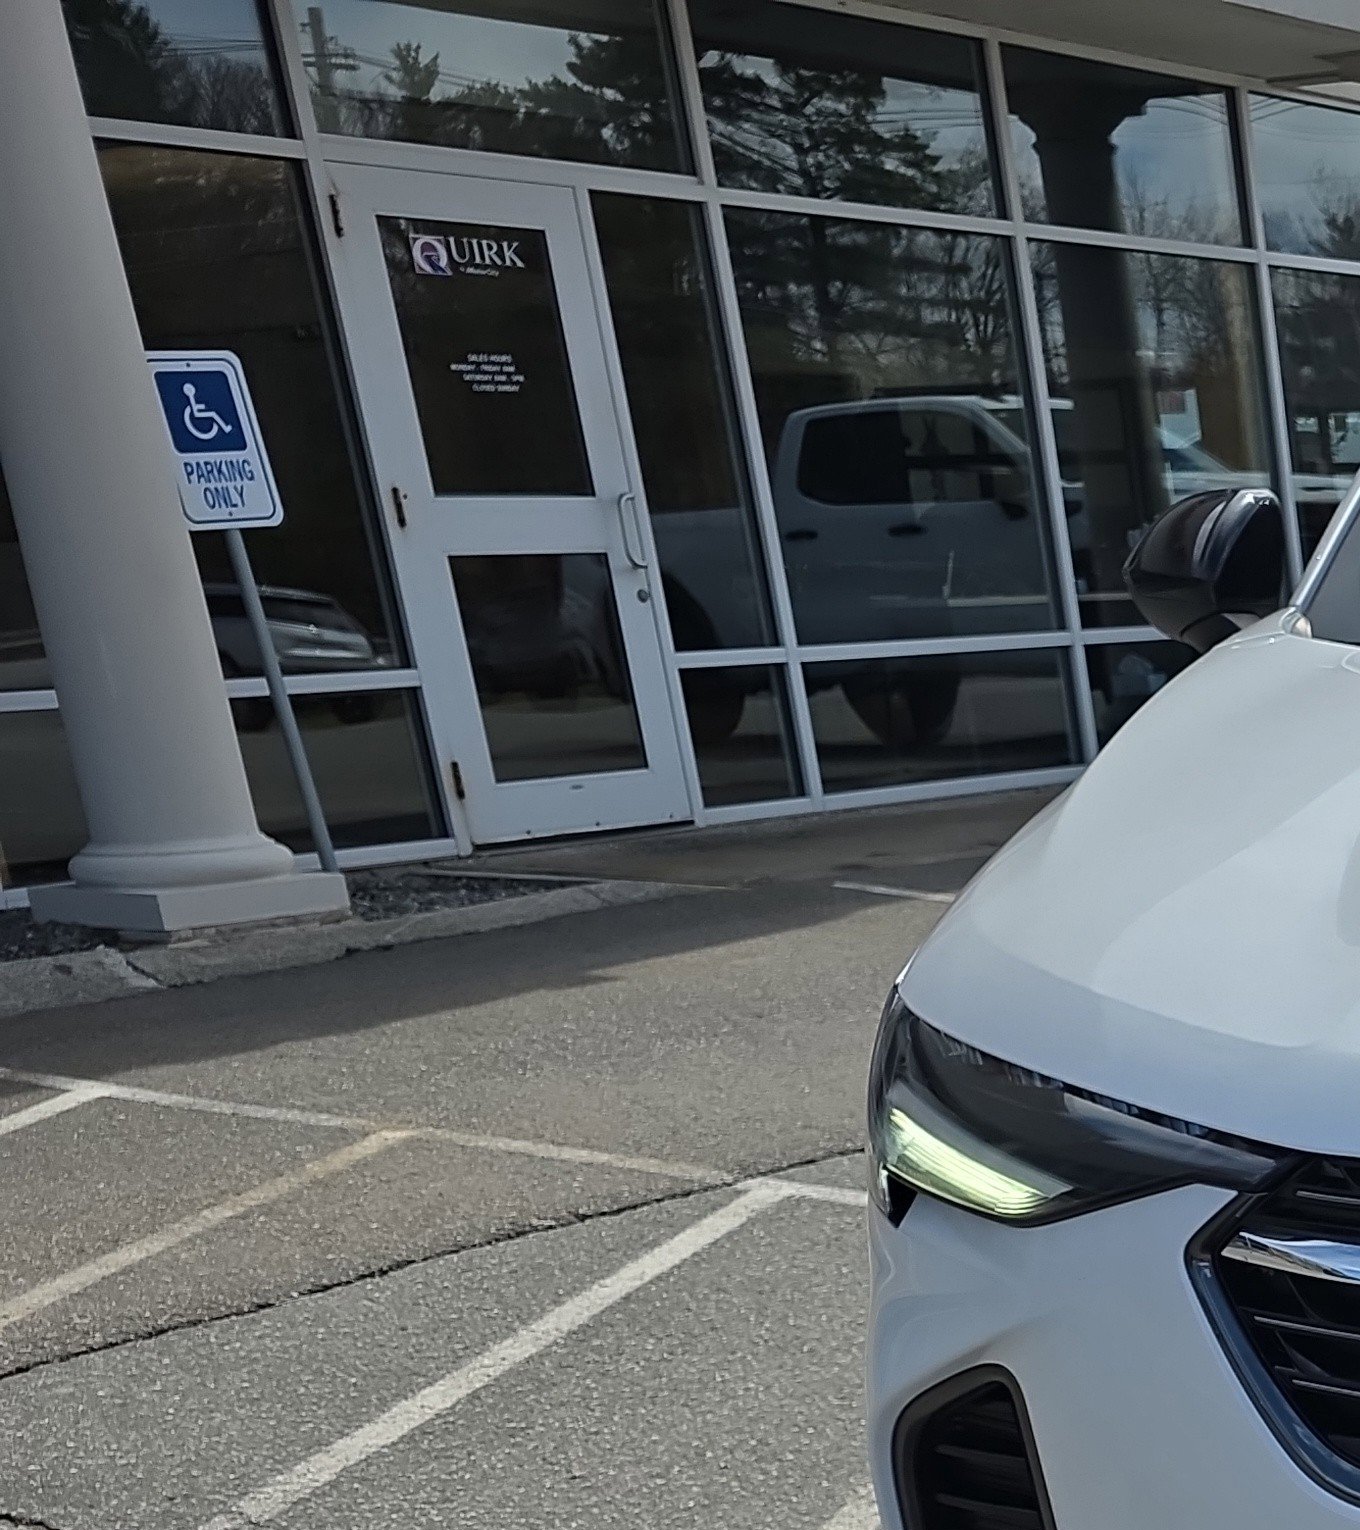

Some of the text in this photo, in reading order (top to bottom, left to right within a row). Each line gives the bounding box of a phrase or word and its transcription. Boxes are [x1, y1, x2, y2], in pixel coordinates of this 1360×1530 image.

[410, 234, 525, 275] QUIRK
[183, 459, 255, 485] PARKING
[203, 484, 246, 510] ONLY
